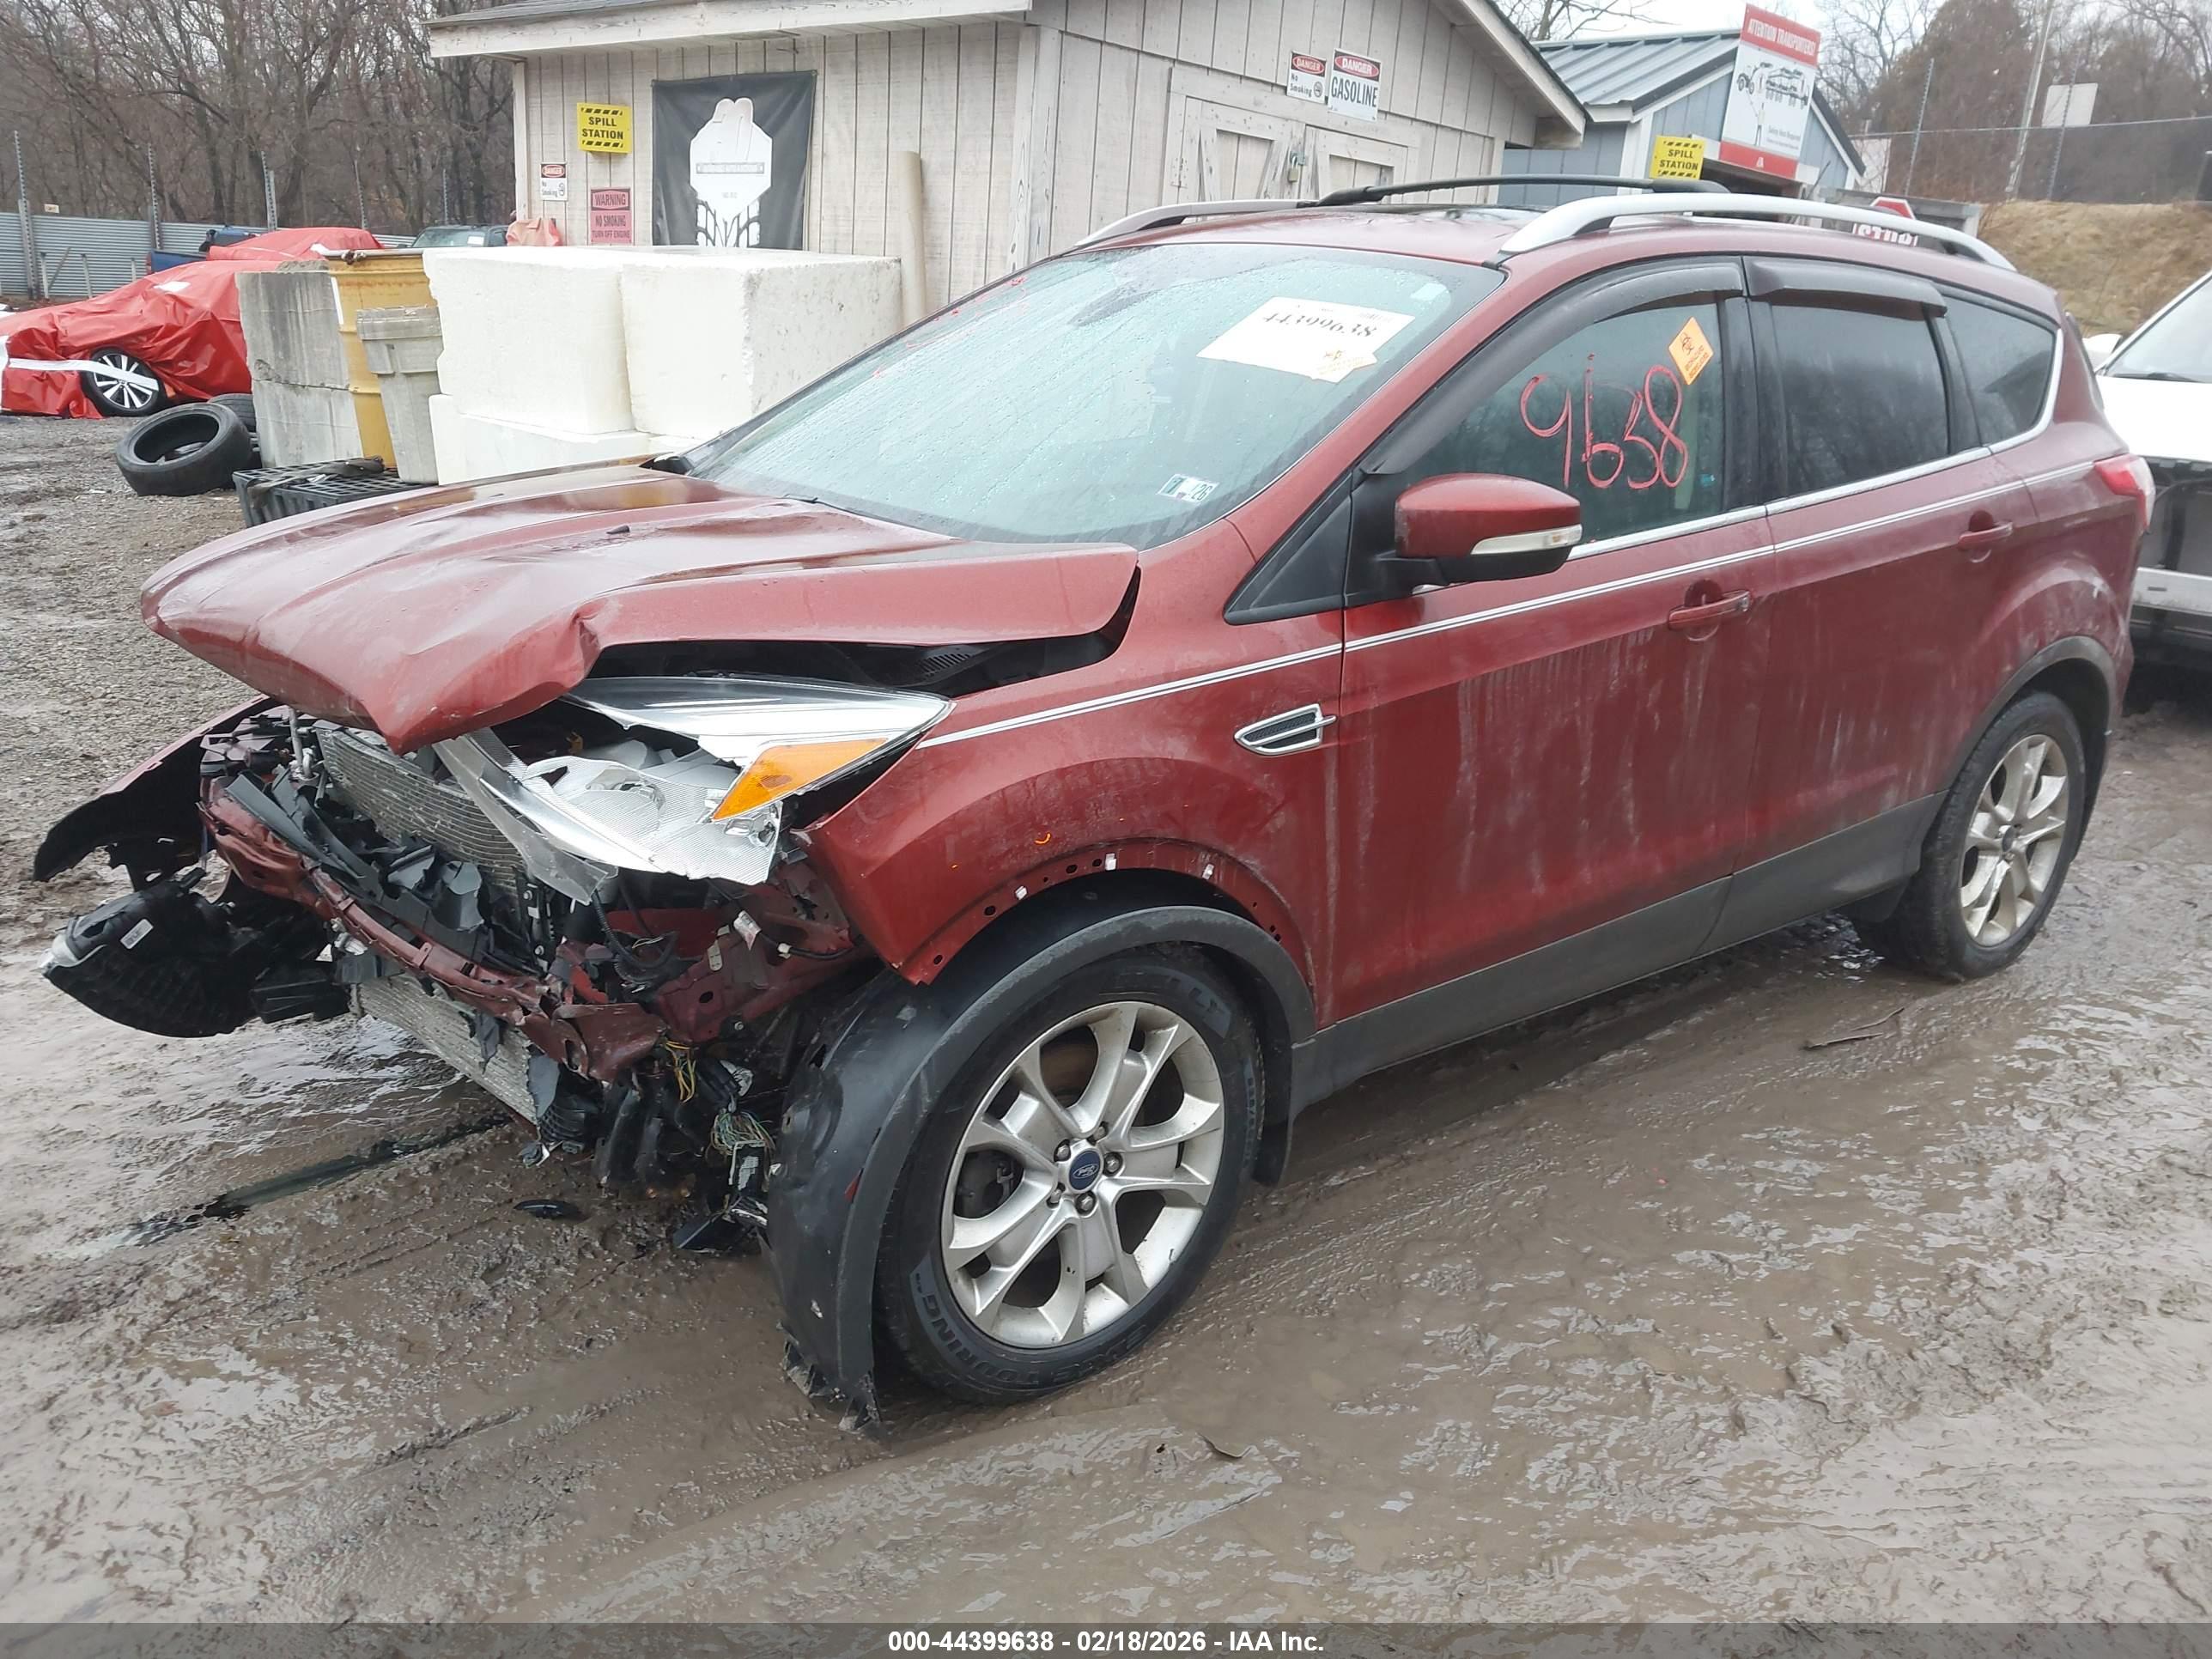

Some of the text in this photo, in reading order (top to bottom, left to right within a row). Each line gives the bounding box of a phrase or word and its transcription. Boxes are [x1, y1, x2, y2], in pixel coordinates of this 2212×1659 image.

[1297, 58, 1321, 71] DANGER
[1342, 58, 1373, 75] DANGER
[1291, 73, 1298, 82] No
[1290, 83, 1312, 97] Smoking
[1331, 76, 1378, 107] GASOLINE
[588, 117, 617, 126] SPILL
[582, 128, 623, 139] STATION
[1668, 149, 1693, 159] SPILL
[1659, 160, 1698, 170] STATION
[595, 194, 626, 205] WARNING
[595, 215, 626, 227] NO SMOKING
[1520, 354, 1689, 489] 9638
